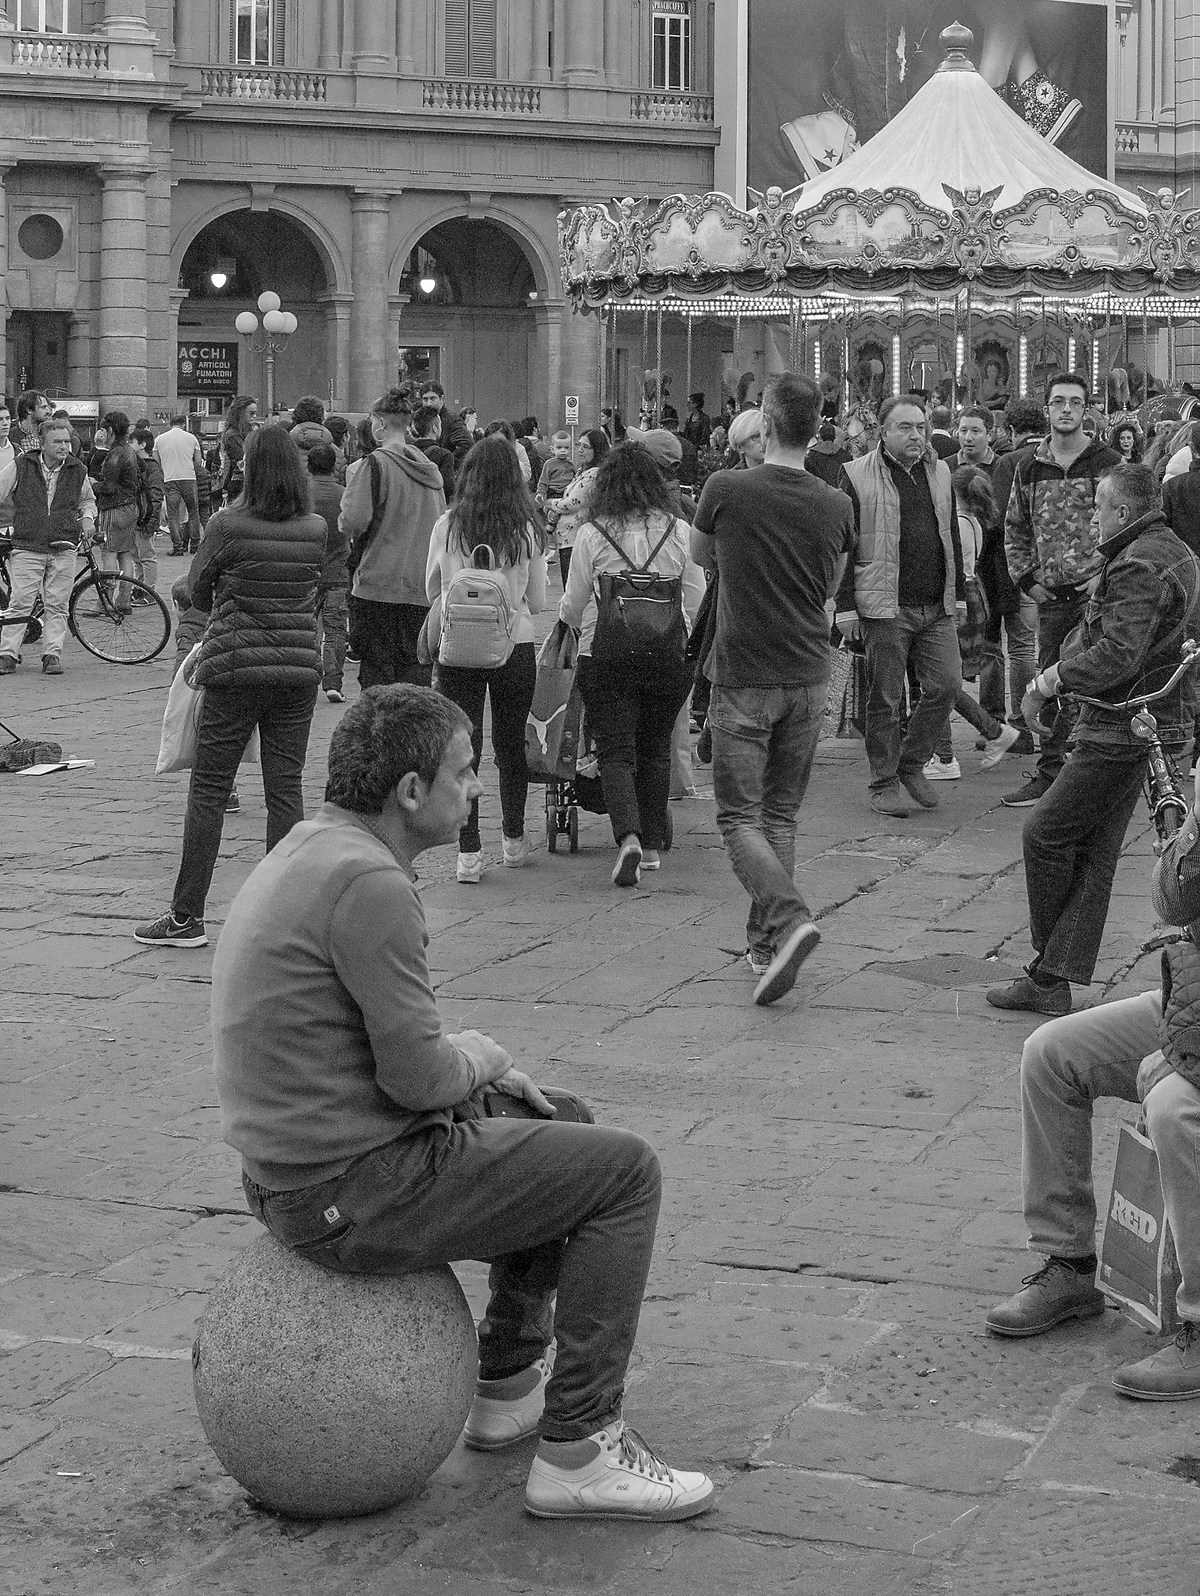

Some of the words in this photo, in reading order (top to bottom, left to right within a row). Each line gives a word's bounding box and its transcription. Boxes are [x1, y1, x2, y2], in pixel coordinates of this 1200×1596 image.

[178, 347, 226, 359] ACCHI
[198, 361, 231, 369] ARTICOLI
[196, 370, 233, 378] FUMATORI
[154, 412, 172, 420] TAXI
